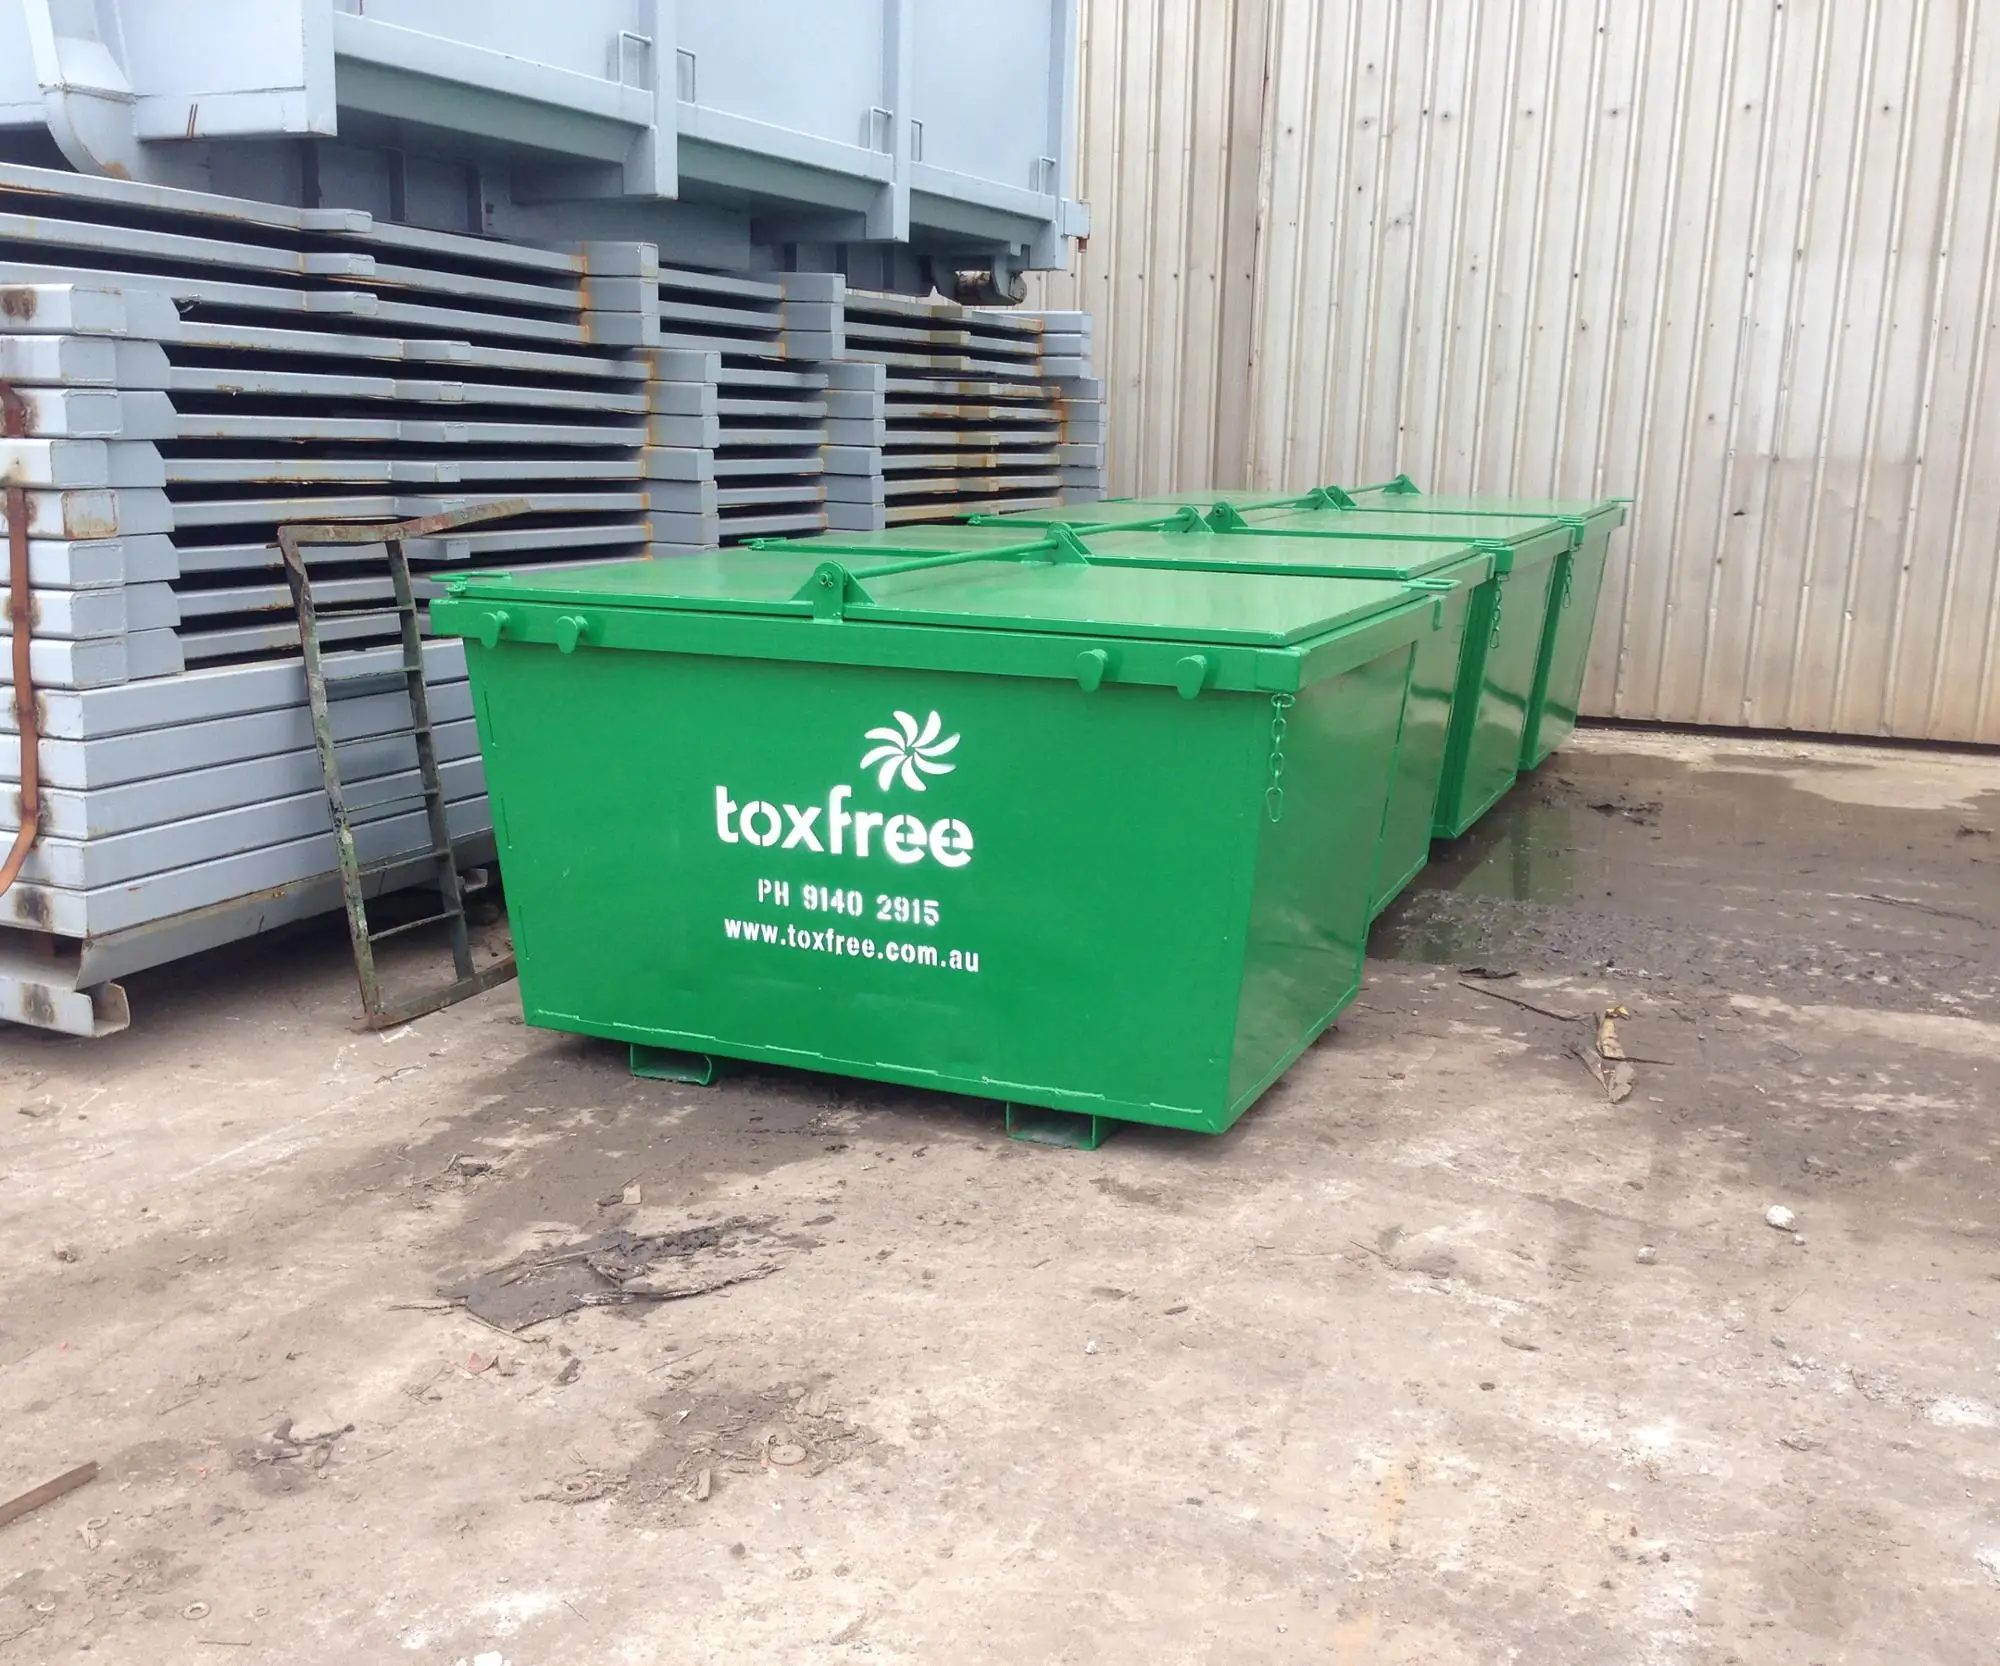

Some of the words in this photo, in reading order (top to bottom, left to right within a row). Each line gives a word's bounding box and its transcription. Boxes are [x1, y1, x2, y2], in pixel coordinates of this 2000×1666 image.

[715, 784, 974, 868] toxfree
[757, 878, 790, 907] PH
[802, 884, 864, 917] 9140
[876, 894, 940, 927] 2915
[724, 918, 979, 972] www.toxfree.com.au
